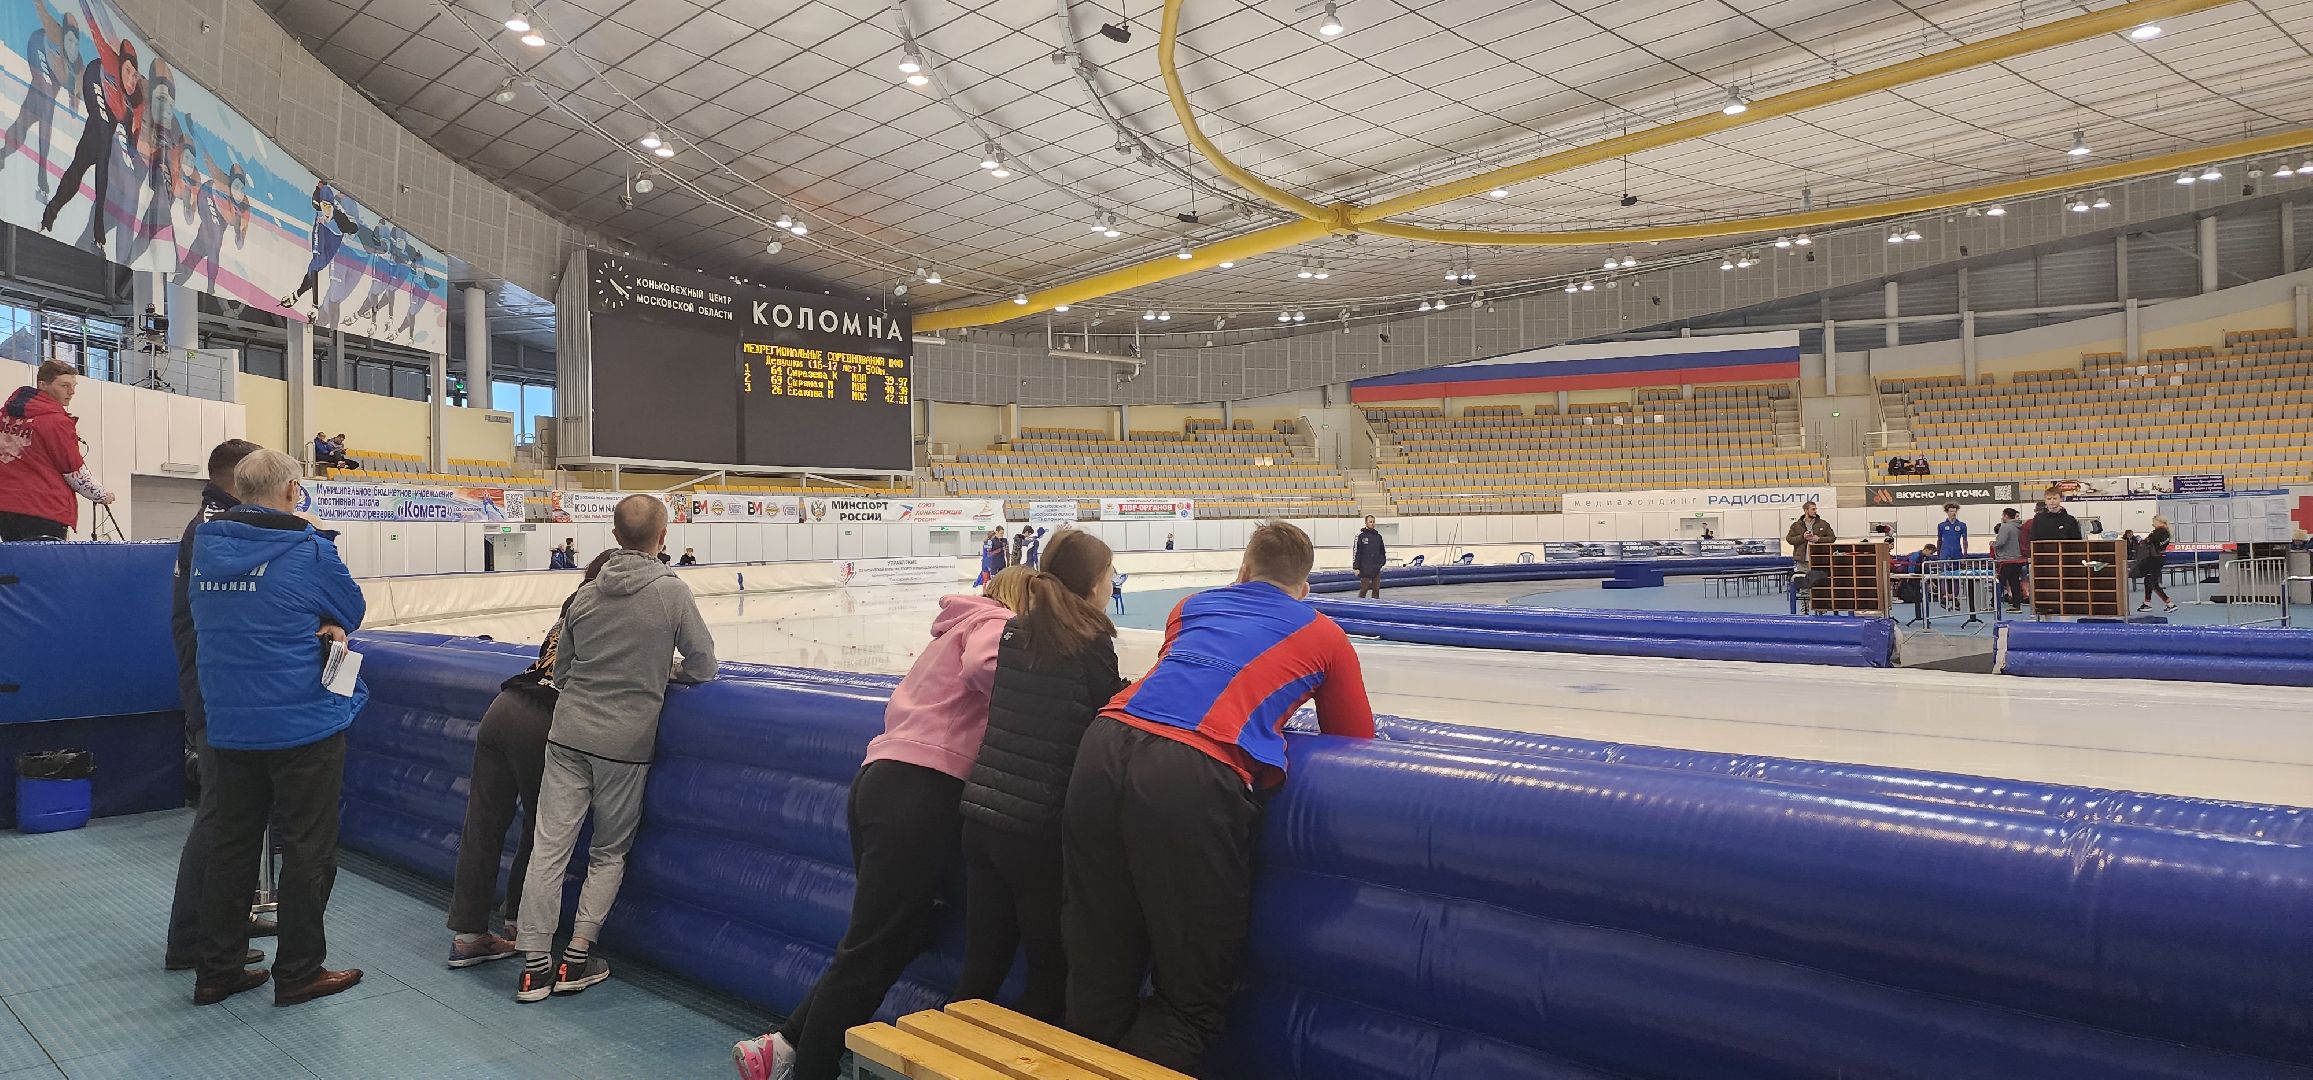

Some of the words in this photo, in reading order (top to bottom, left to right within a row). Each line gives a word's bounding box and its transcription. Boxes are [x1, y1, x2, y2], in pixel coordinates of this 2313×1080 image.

[636, 277, 704, 299] КОНЬКОБЕЖНЫЙ
[709, 292, 732, 304] ЦЕНТР
[636, 294, 695, 313] МОСКОВСКОЙ
[698, 306, 733, 320] ОБЛАСТИ
[752, 300, 903, 342] КОЛОМНА
[744, 363, 750, 373] 1
[744, 373, 751, 382] 2
[744, 382, 751, 392] 3
[316, 484, 372, 496] Муниципальное
[373, 486, 412, 498] бюджетное
[414, 489, 454, 499] учреждение
[1896, 491, 1936, 499] ВКУСНО
[1955, 489, 1991, 498] ТОЧКА
[317, 497, 356, 507] спортивная
[831, 500, 889, 511] МИНСПОРТ
[1708, 493, 1820, 507] РАДИОСИТИ
[397, 500, 453, 519] «Комета»
[839, 512, 882, 522] РОССИИ
